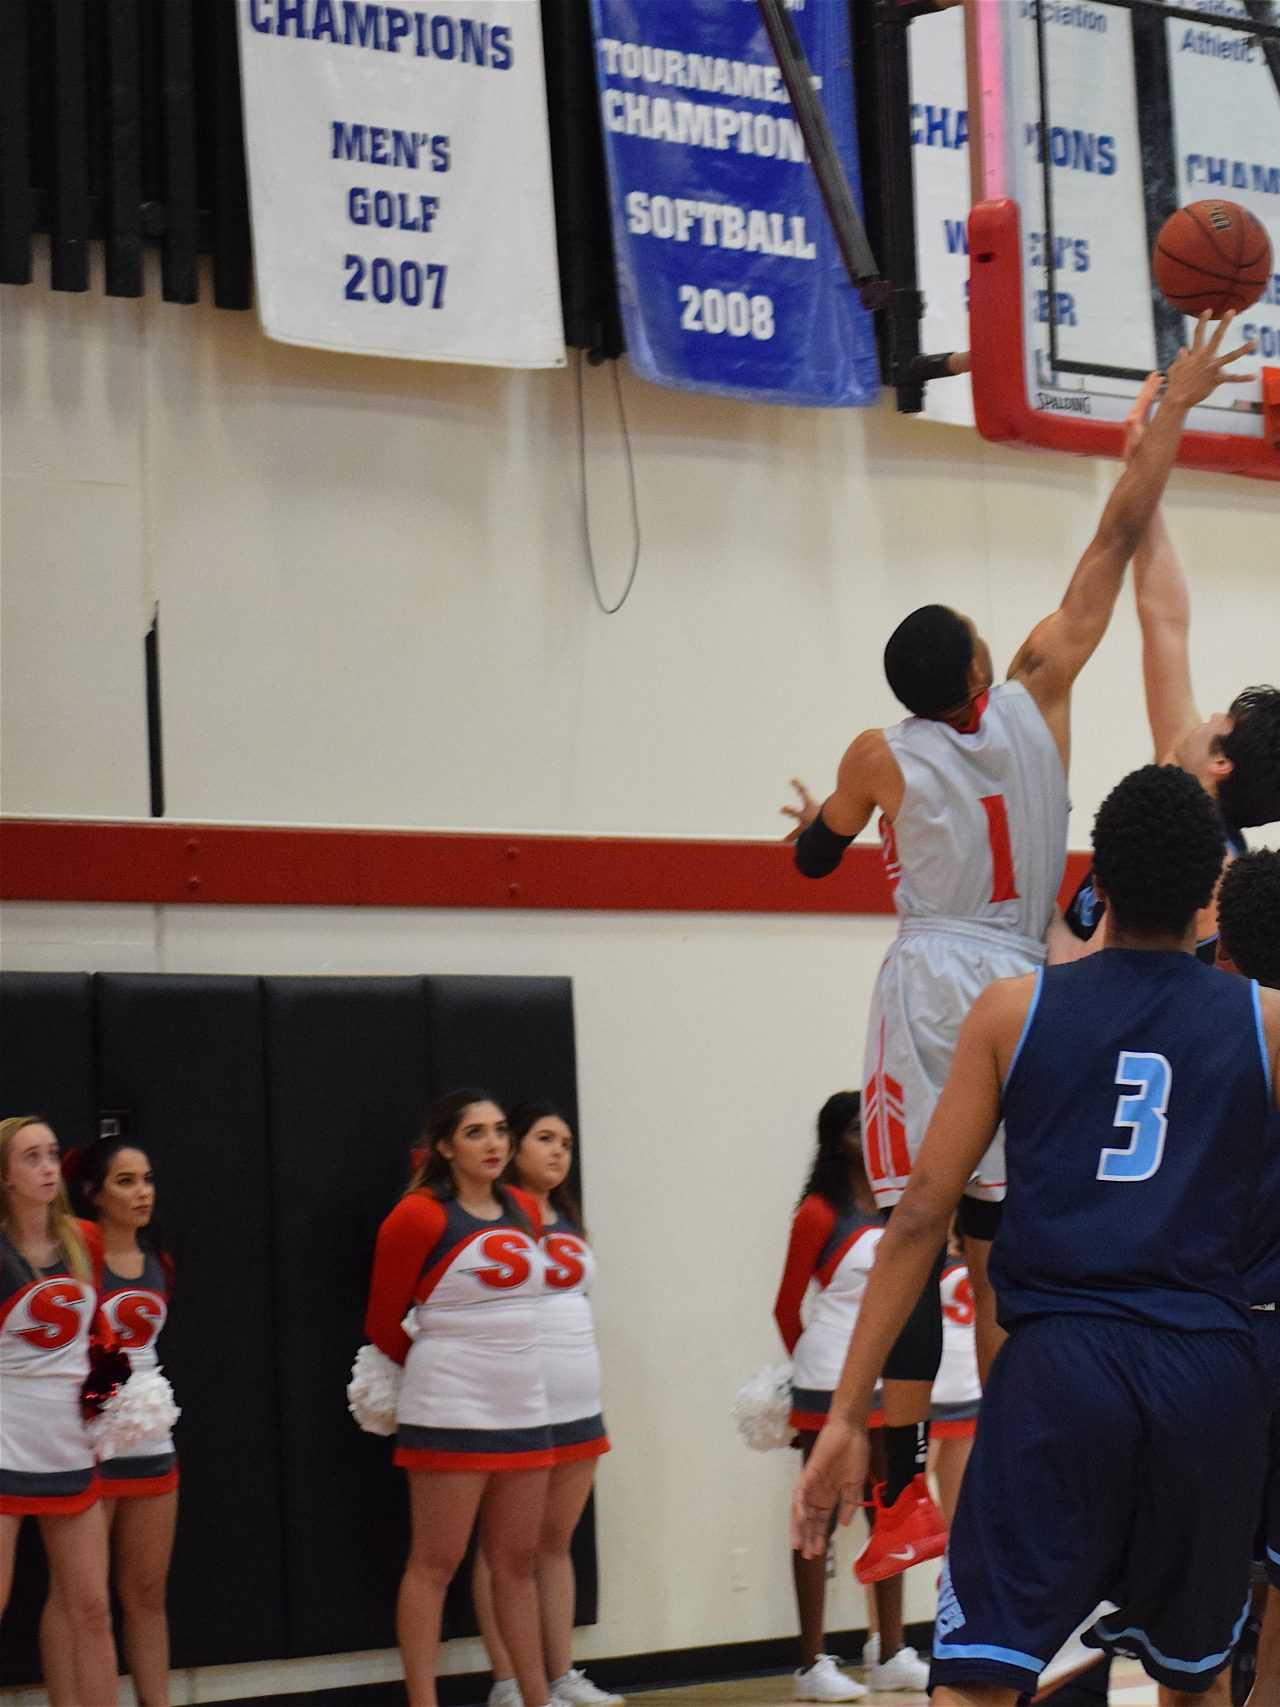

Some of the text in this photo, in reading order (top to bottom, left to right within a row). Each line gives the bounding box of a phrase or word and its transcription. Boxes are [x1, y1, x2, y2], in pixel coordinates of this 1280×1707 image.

[251, 0, 514, 70] CHAMPIONS
[600, 38, 822, 104] TOURNAME
[331, 120, 450, 173] MEN'S
[348, 187, 439, 232] GOLF
[626, 191, 817, 260] SOFTBALL
[344, 254, 448, 309] 2007
[679, 285, 775, 341] 2008
[977, 793, 1021, 904] 1
[1096, 1051, 1173, 1182] 3
